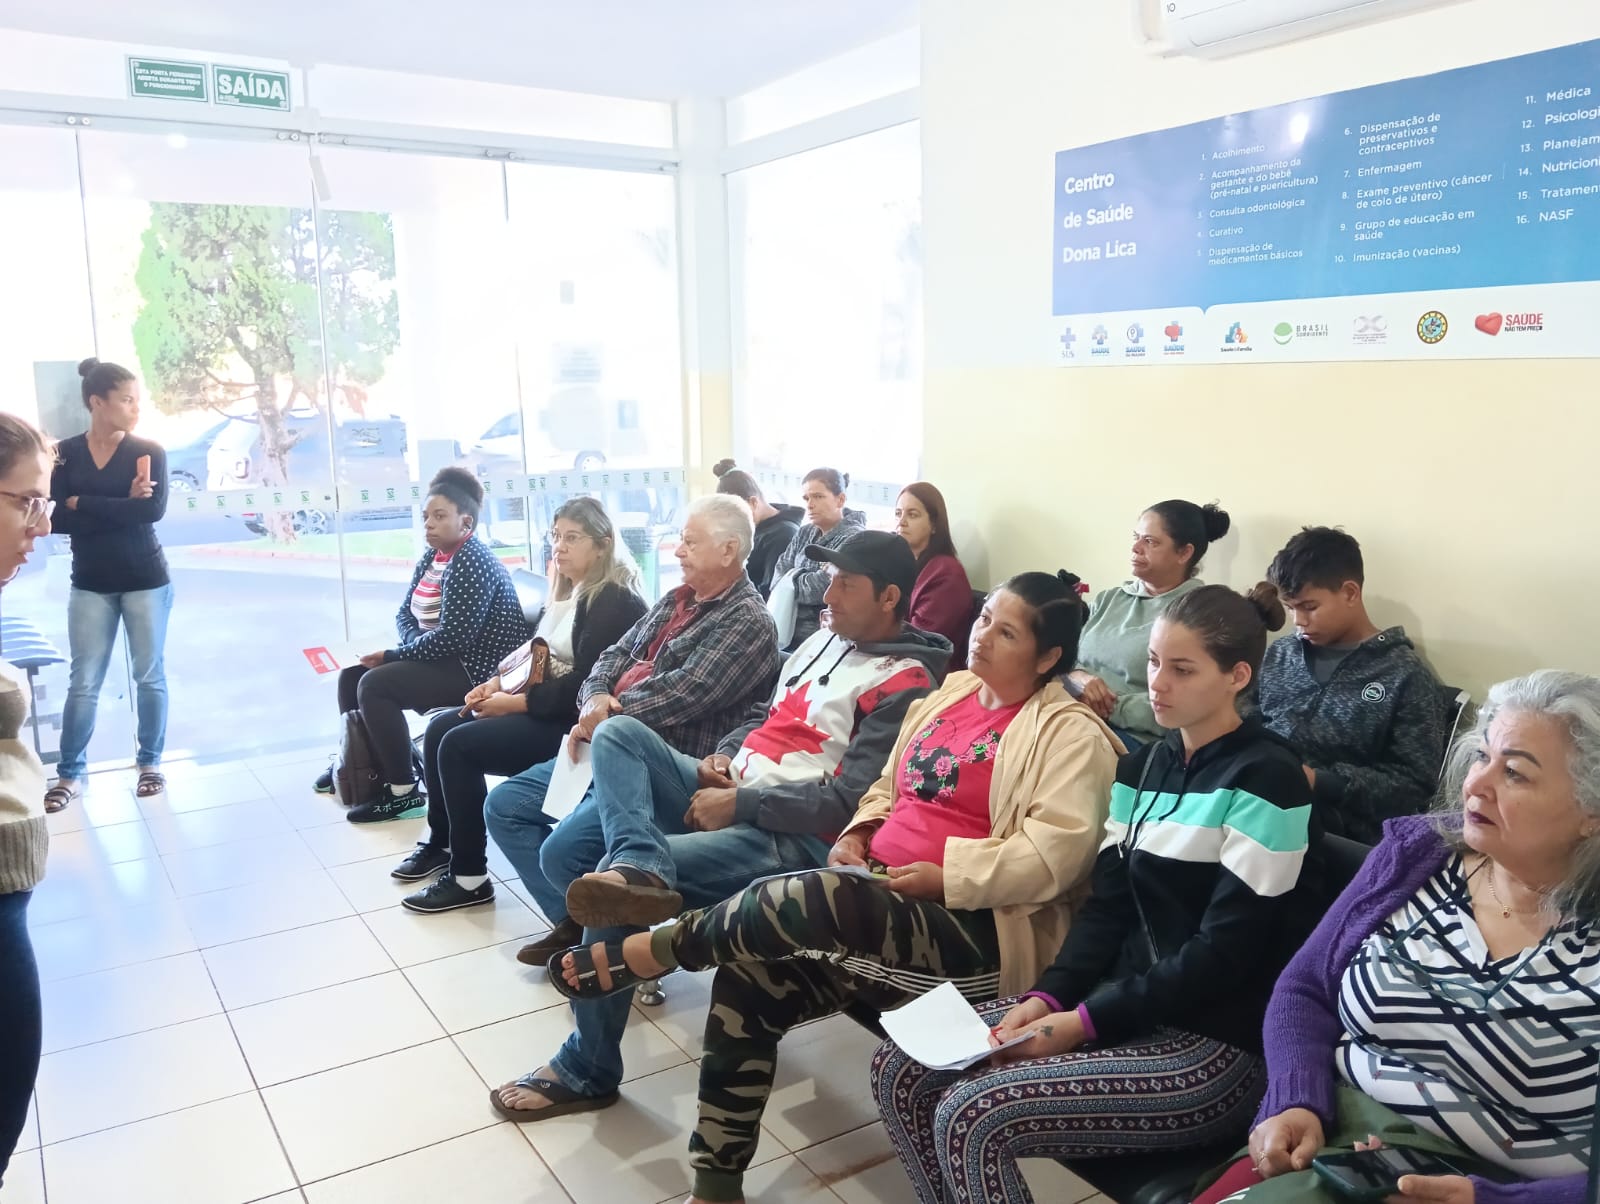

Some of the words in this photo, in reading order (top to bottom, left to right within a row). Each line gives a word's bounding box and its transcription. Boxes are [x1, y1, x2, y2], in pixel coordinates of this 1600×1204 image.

[219, 72, 285, 101] SAÍDA
[1525, 95, 1537, 105] 11.
[1546, 87, 1592, 102] Médica
[1360, 115, 1425, 134] Dispensação
[1427, 112, 1441, 122] de
[1522, 119, 1535, 129] 12.
[1359, 127, 1429, 145] preservativos
[1431, 124, 1438, 133] e
[1520, 143, 1534, 153] 13.
[1543, 134, 1600, 151] Planejam
[1212, 144, 1265, 160] Acolhimento
[1358, 136, 1435, 155] contraceptivos
[1211, 160, 1288, 179] Acompanhamento
[1290, 158, 1301, 167] da
[1357, 160, 1422, 177] Enfermagem
[1518, 167, 1532, 177] 14.
[1064, 172, 1115, 194] Centro
[1210, 177, 1246, 190] gestante
[1256, 173, 1267, 182] do
[1270, 169, 1291, 180] bebê
[1210, 184, 1252, 200] (pré-natal
[1253, 185, 1259, 193] e
[1261, 176, 1319, 193] puericultura)
[1357, 186, 1390, 199] Exame
[1392, 179, 1448, 195] preventivo
[1451, 173, 1492, 188] (câncer
[1356, 199, 1368, 209] de
[1370, 196, 1392, 207] colo
[1394, 194, 1407, 204] de
[1410, 190, 1443, 202] útero)
[1541, 184, 1600, 199] Tratamen
[1063, 211, 1082, 229] de
[1086, 203, 1134, 226] Saúde
[1209, 205, 1245, 218] Consulta
[1247, 198, 1305, 213] odontológica
[1516, 215, 1530, 225] 16.
[1539, 208, 1574, 223] NASF
[1355, 219, 1386, 232] Grupo
[1388, 217, 1401, 227] de
[1403, 211, 1455, 225] educação
[1457, 209, 1475, 219] em
[1209, 225, 1244, 237] Curativo
[1354, 231, 1384, 241] saúde
[1062, 245, 1101, 263] Dona
[1105, 240, 1137, 259] Lica
[1208, 243, 1261, 256] Dispensação
[1262, 242, 1273, 251] de
[1208, 252, 1268, 265] medicamentos
[1270, 248, 1303, 260] básicos
[1353, 248, 1410, 263] Imunização
[1412, 244, 1461, 258] (vacinas)
[1296, 324, 1329, 332] BRASIL
